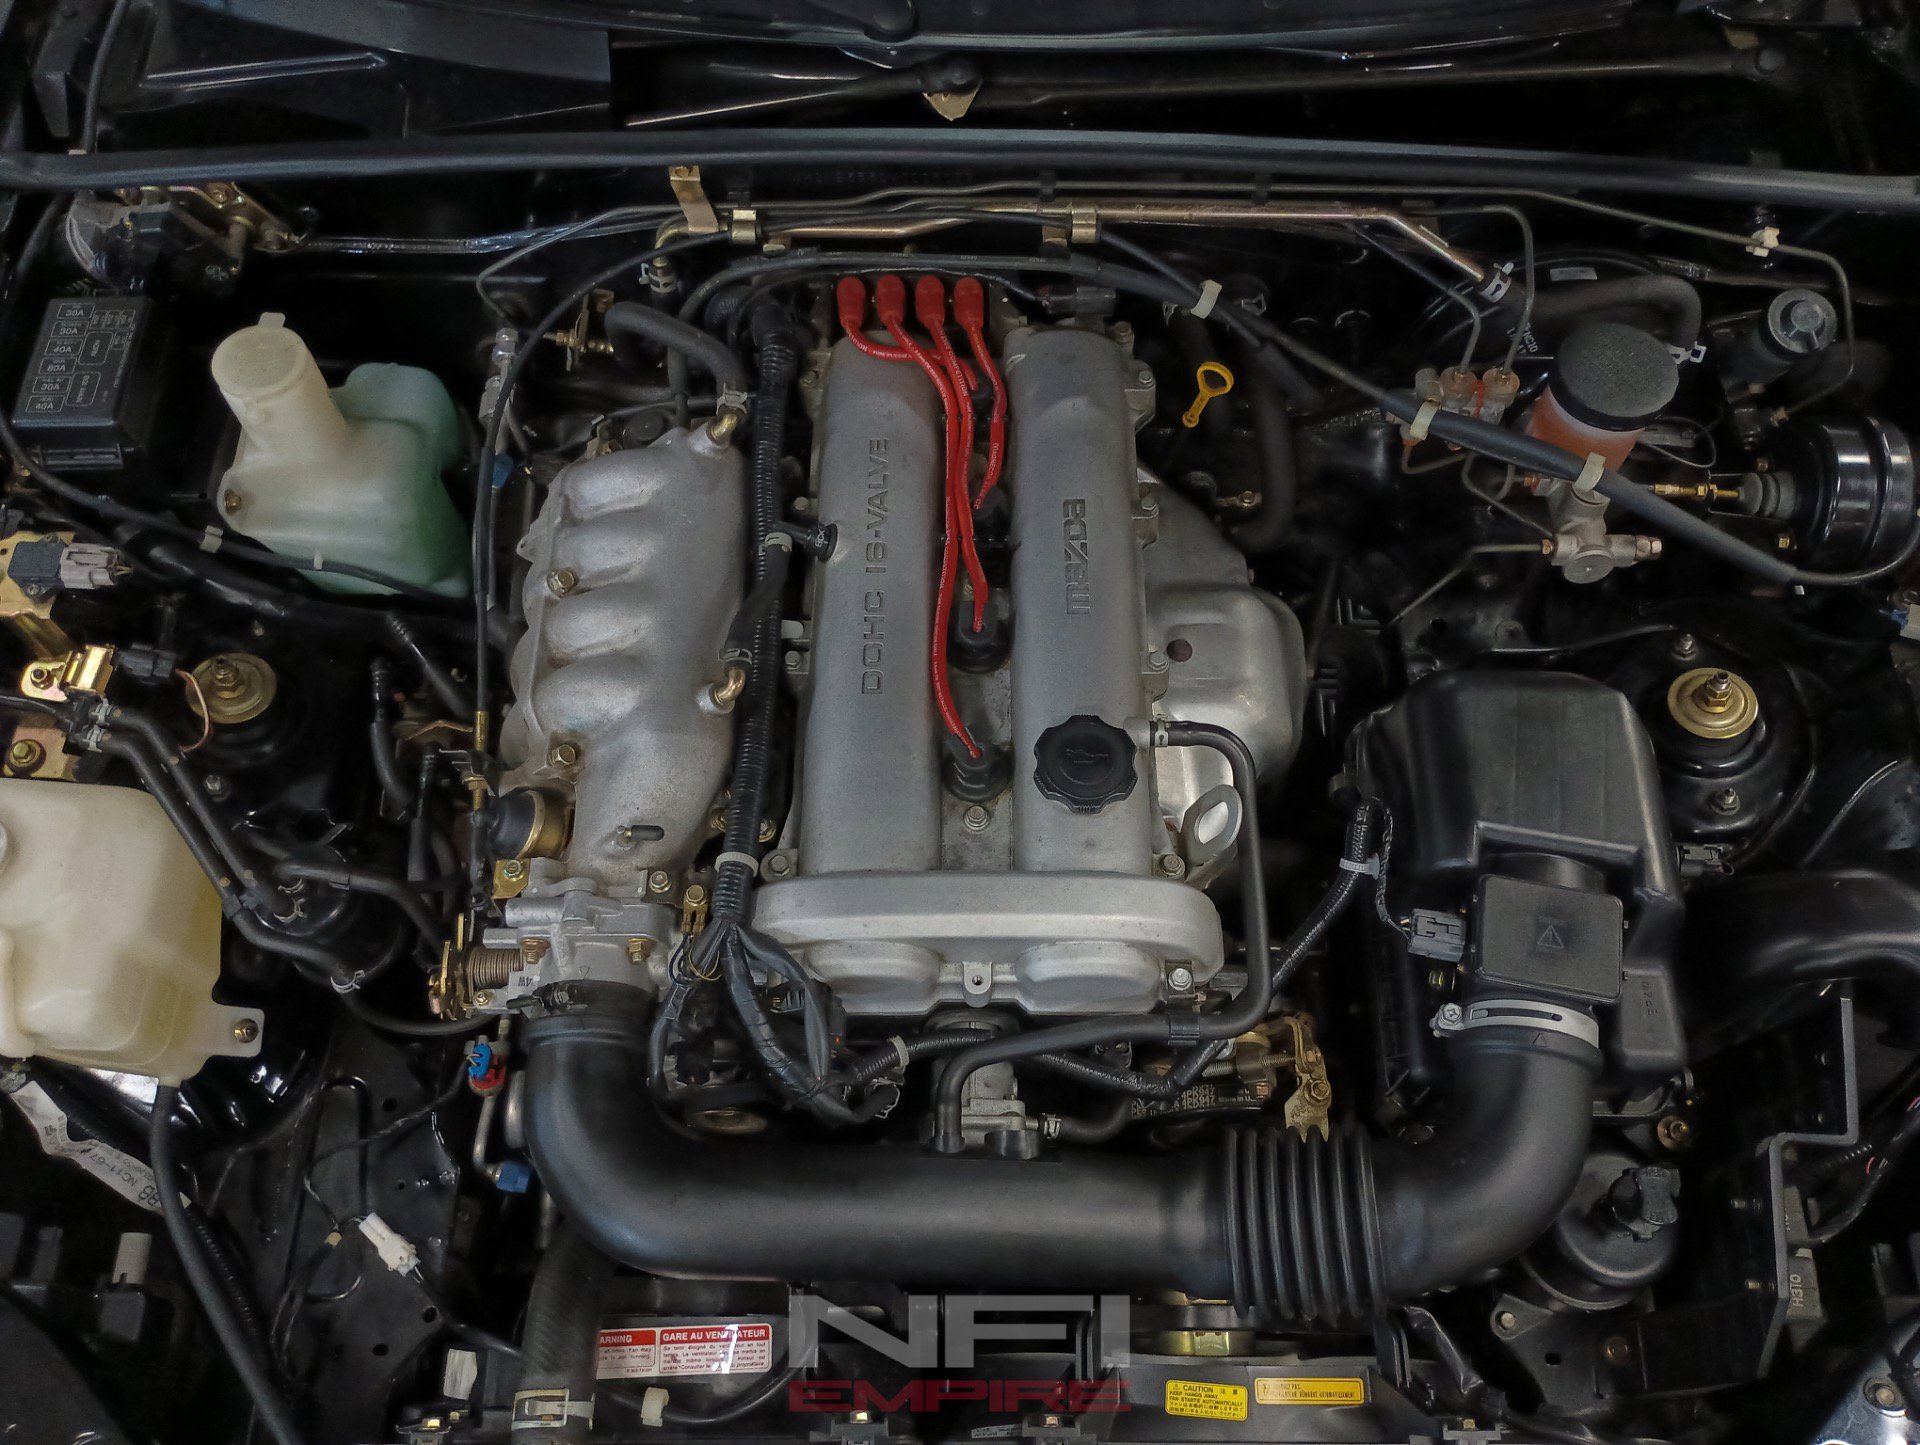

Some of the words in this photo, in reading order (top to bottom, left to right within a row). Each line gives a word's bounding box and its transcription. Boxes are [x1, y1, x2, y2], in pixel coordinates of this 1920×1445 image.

[861, 590, 885, 695] DOHC
[1789, 1273, 1804, 1308] H310
[599, 1334, 633, 1344] ARNING
[662, 1332, 688, 1342] GARE
[690, 1331, 703, 1340] AU
[1183, 1385, 1214, 1393] CAUTION
